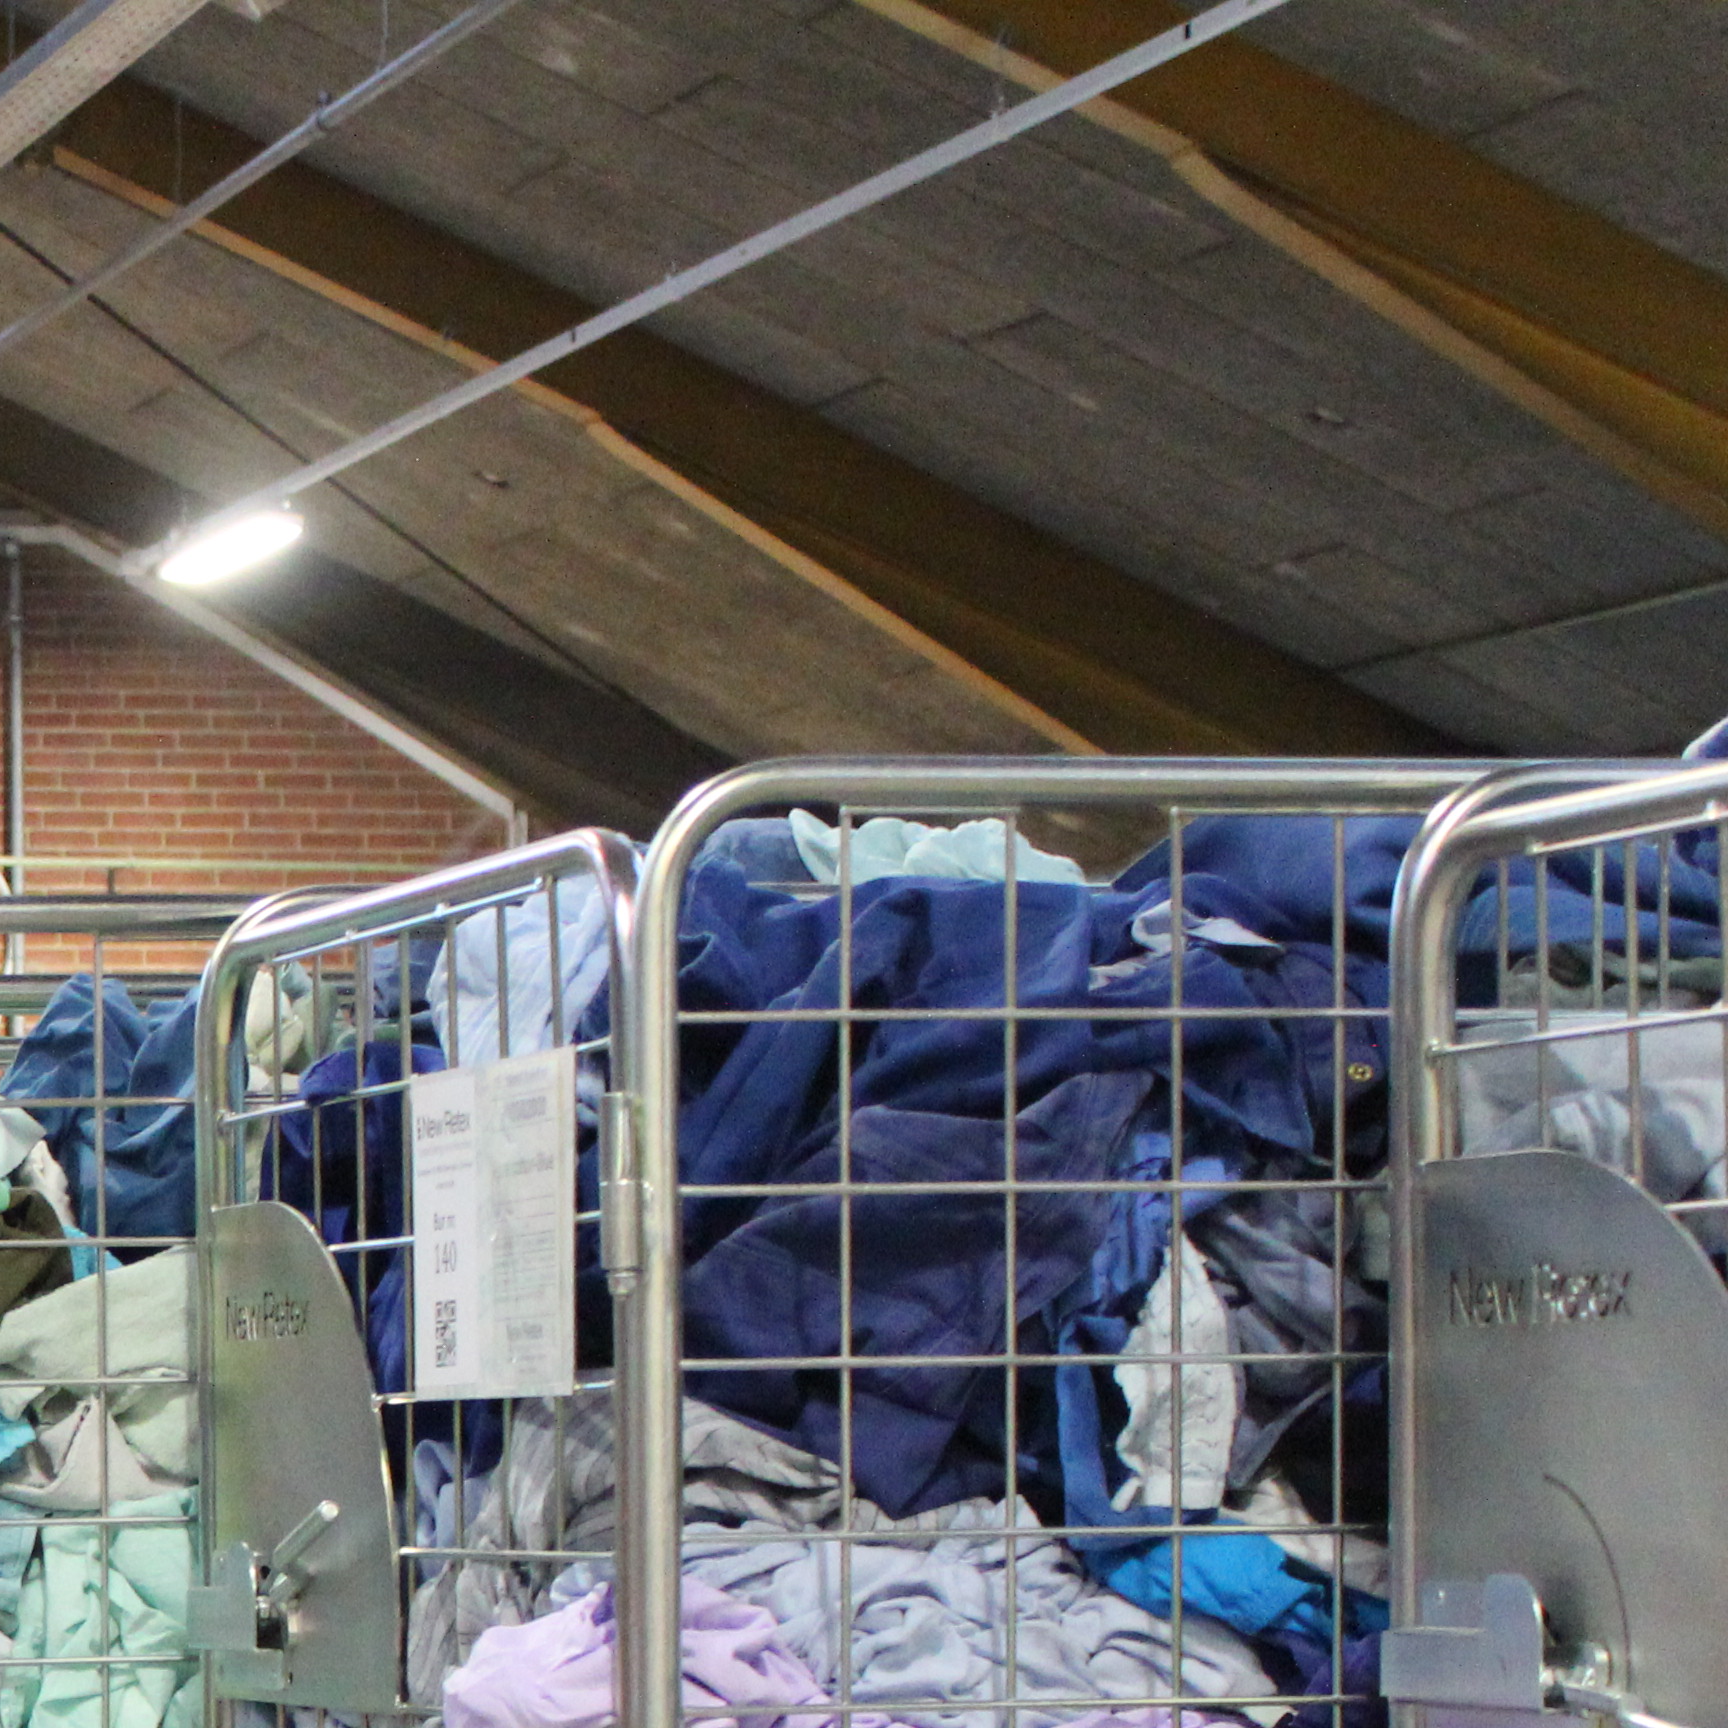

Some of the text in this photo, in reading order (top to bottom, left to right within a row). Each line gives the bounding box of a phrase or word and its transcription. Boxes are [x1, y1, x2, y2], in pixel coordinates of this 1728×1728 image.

[226, 1291, 310, 1342] New Retex
[1446, 1263, 1633, 1328] New Retex
